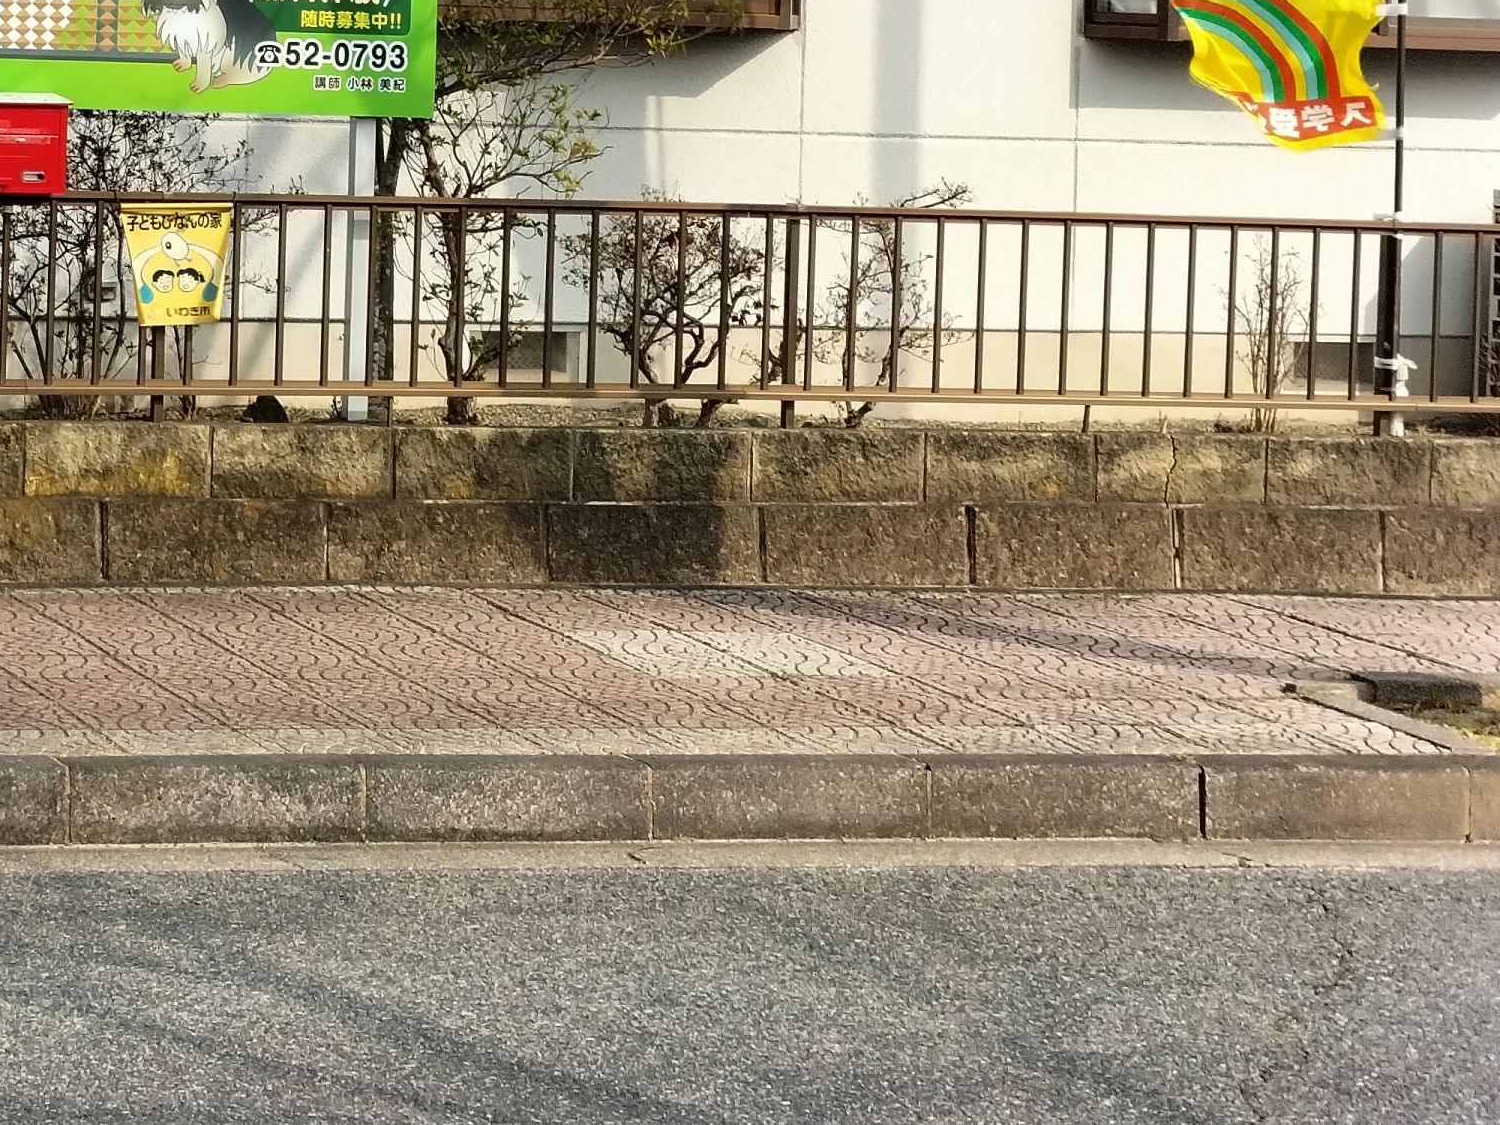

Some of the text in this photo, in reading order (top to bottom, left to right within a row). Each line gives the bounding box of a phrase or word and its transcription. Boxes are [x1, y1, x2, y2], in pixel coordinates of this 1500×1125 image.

[285, 41, 406, 69] 52-0793
[314, 76, 406, 92] 講師 小林 美紀
[166, 305, 212, 318] いわき市
